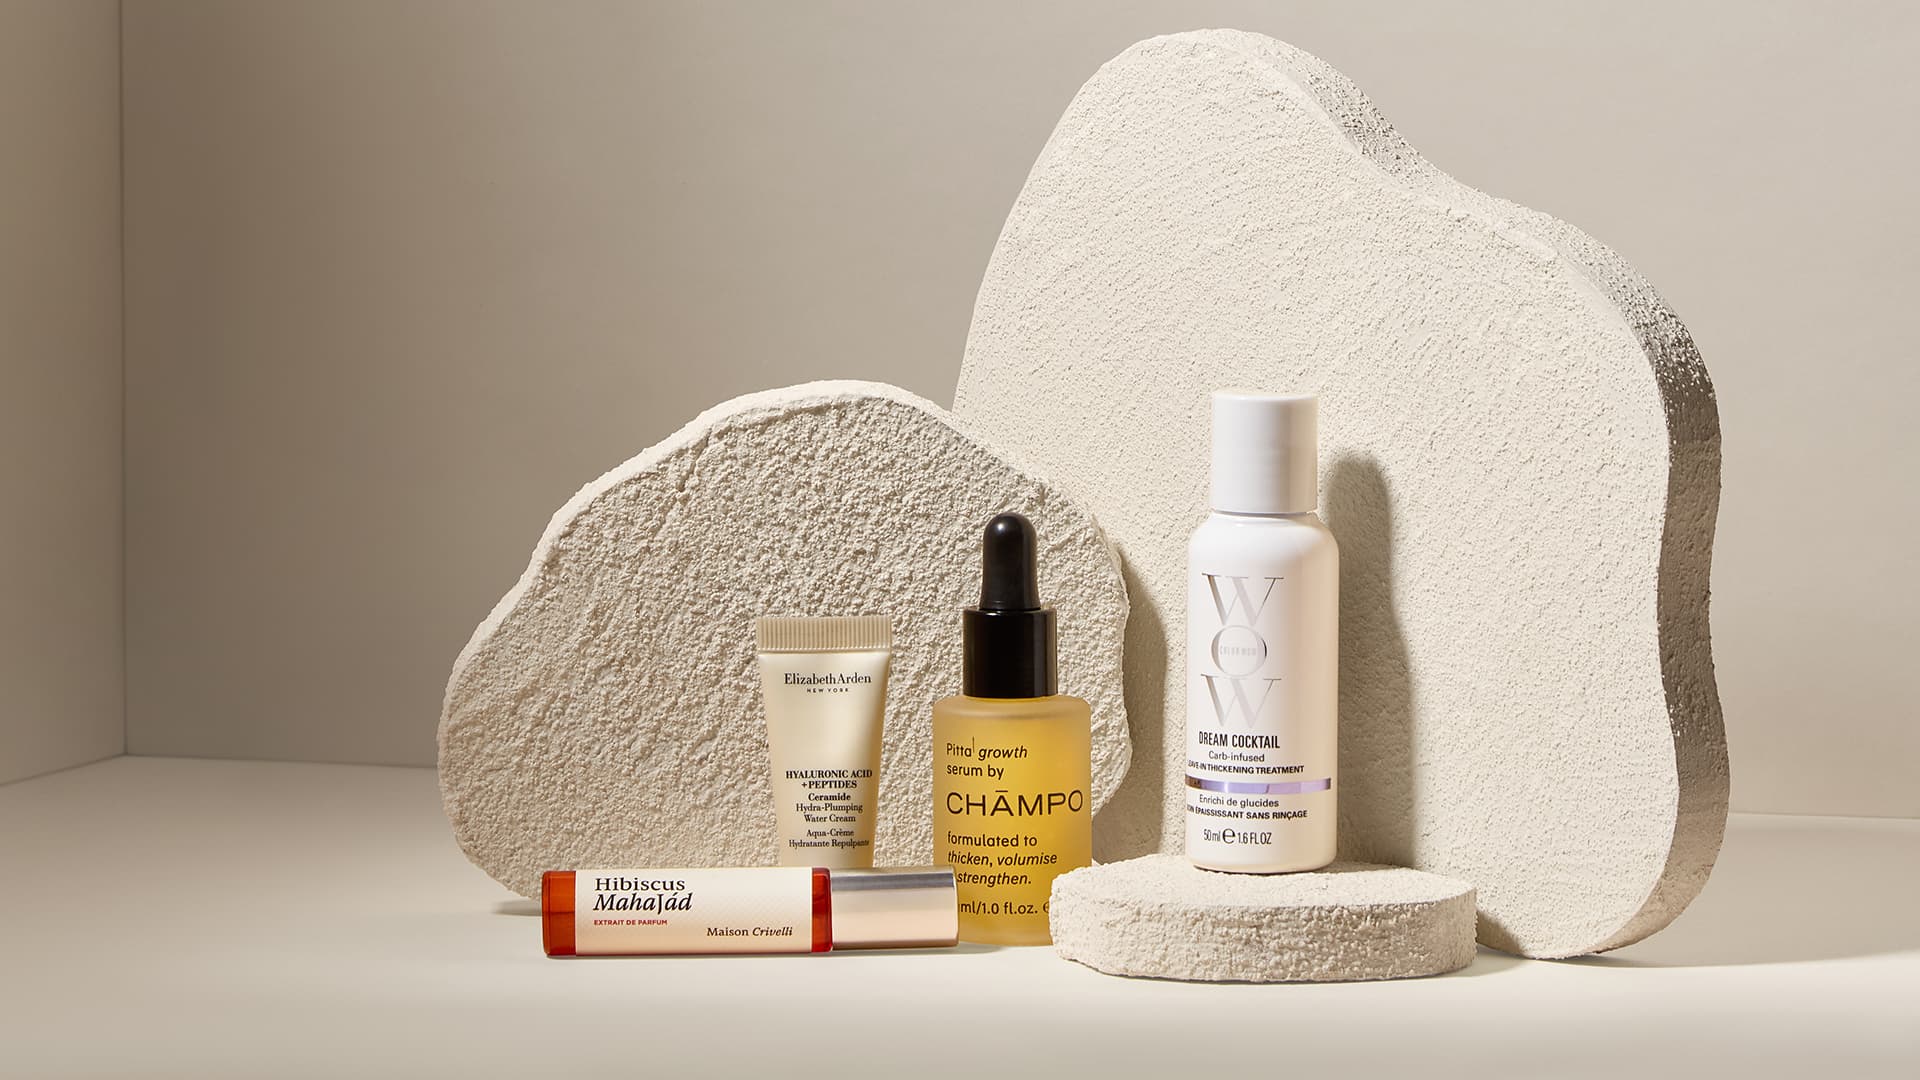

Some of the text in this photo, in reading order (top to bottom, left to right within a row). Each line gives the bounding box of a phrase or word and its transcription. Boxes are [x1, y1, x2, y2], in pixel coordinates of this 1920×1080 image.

[784, 672, 871, 684] Elizabeth Arden
[1199, 731, 1280, 748] DREAM COCKTAIL
[978, 745, 1028, 761] growth
[1208, 751, 1265, 762] Carb-infused
[946, 764, 1004, 780] serum by
[1188, 759, 1305, 775] EAVE-IN THICKENING TREATMENT
[785, 770, 872, 779] HYALURONIC ACID
[801, 780, 857, 789] +PEPTIDES
[808, 793, 851, 801] Ceramide
[946, 789, 1083, 816] CHĀMPO
[1199, 794, 1279, 811] Enrichi de glucides
[796, 803, 863, 814] Hydra-Plumping
[1246, 811, 1270, 820] SANS
[1272, 810, 1307, 821] RINÇAGE
[804, 814, 856, 822] Water Cream
[806, 828, 854, 839] Aqua-Crème
[947, 831, 1038, 847] formulated to
[789, 840, 830, 849] Hydratante
[947, 851, 1057, 867] thicken, volumise
[594, 877, 685, 891] Hibiscus
[957, 872, 1032, 888] strengthen.
[592, 892, 693, 915] MahaJád
[958, 901, 999, 915] ml/1.0
[706, 926, 793, 936] Maison Crivelli
